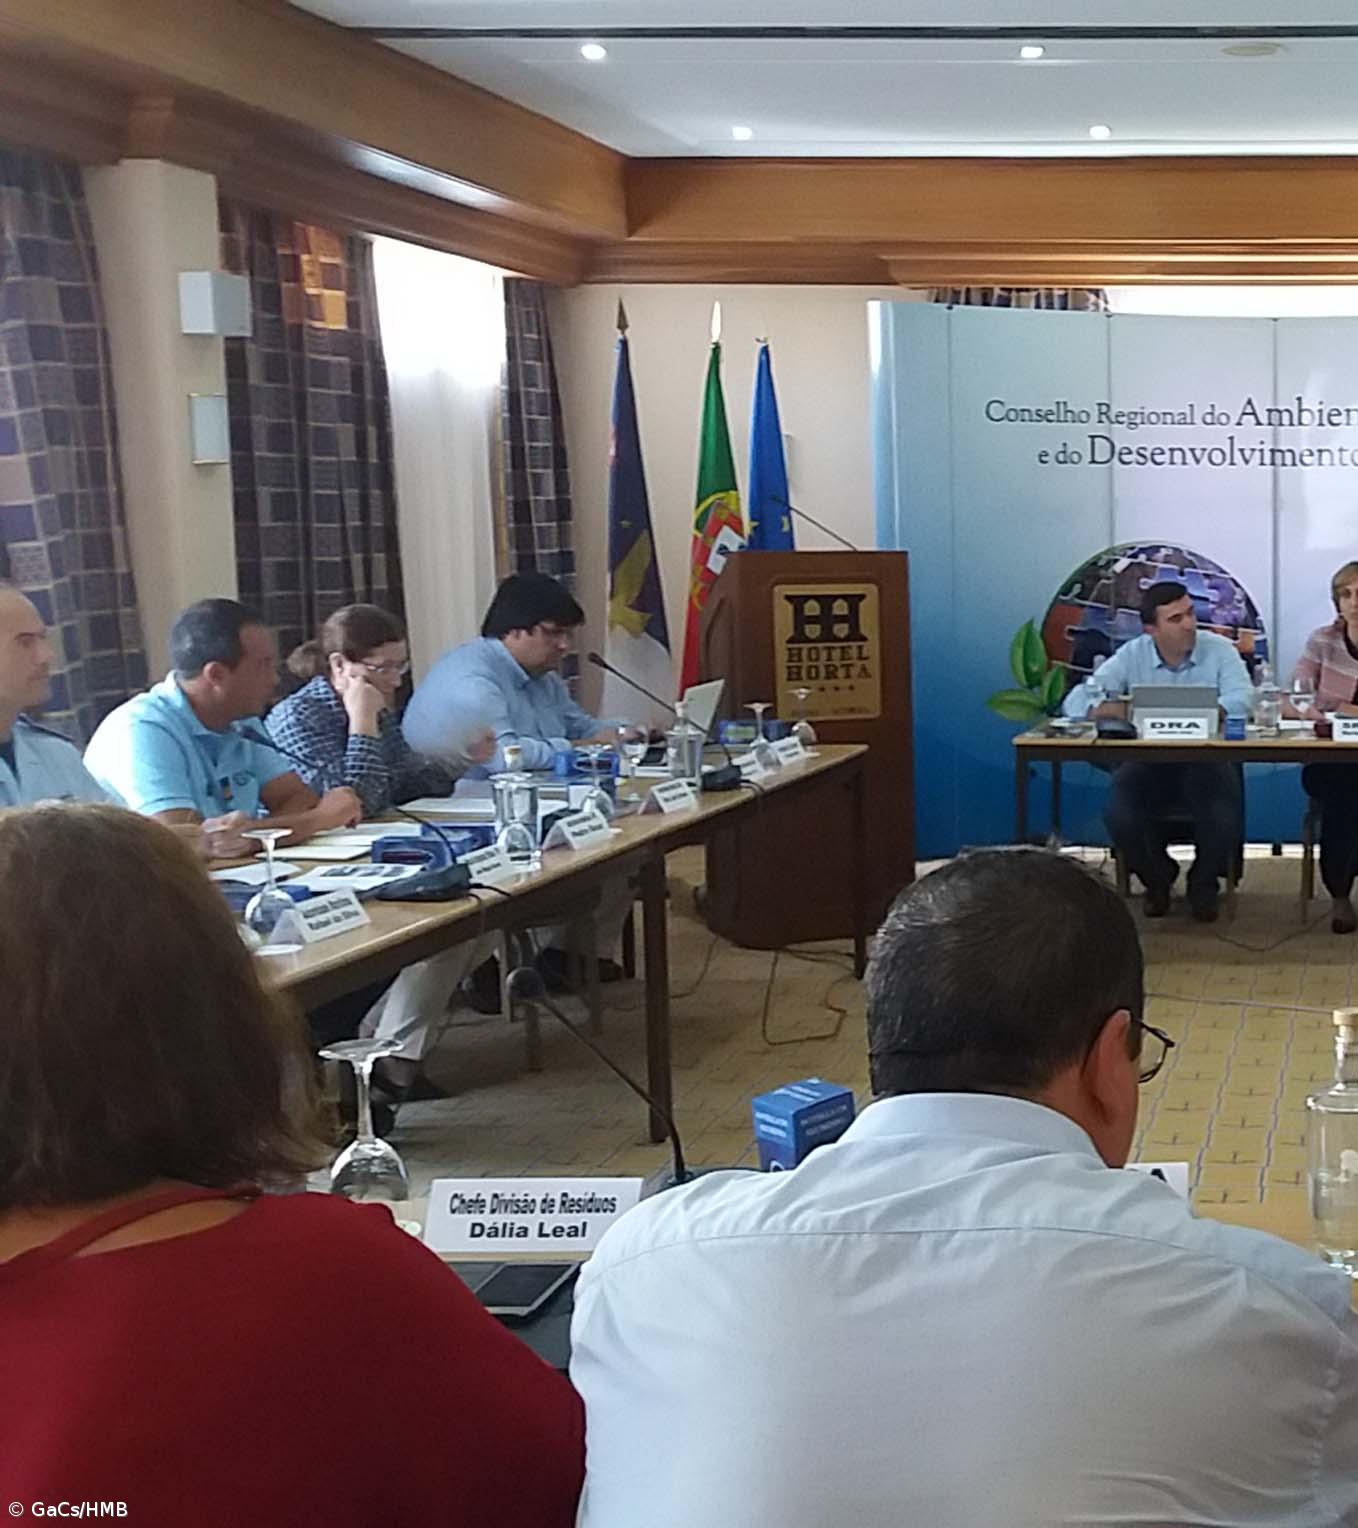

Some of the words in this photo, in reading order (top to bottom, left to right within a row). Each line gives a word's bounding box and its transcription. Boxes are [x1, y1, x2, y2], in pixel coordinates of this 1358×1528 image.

[985, 399, 1091, 424] Conselho
[1096, 402, 1196, 430] Regional
[1202, 404, 1231, 427] do
[1037, 448, 1050, 465] e
[1055, 442, 1082, 465] do
[786, 646, 870, 663] HOTEL
[786, 663, 872, 681] HORTA
[1149, 721, 1201, 730] DRA
[450, 1192, 486, 1214] Chefe
[490, 1192, 536, 1214] Divisão
[540, 1192, 556, 1214] de
[559, 1191, 617, 1214] Resíduos
[469, 1221, 529, 1238] Dália
[537, 1221, 588, 1238] Leal
